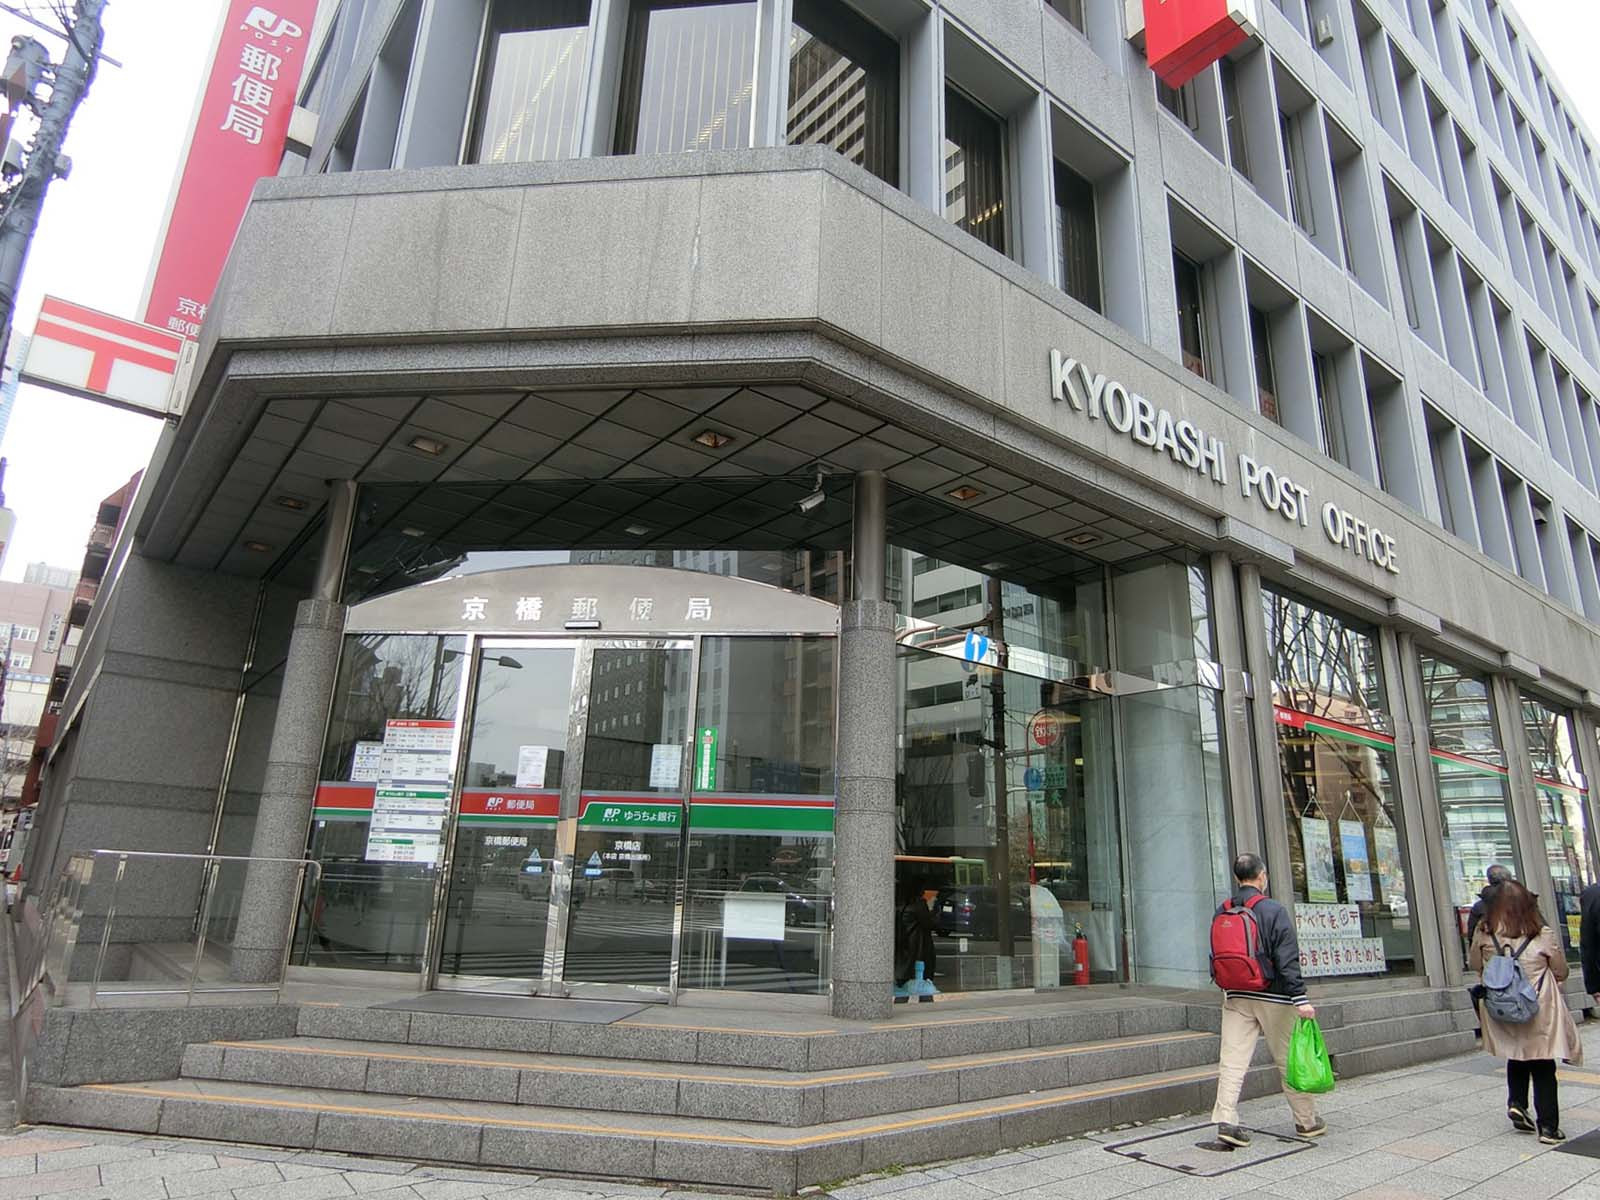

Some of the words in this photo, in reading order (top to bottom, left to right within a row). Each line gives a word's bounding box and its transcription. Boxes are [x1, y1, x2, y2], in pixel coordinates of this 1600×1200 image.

[220, 43, 282, 145] 郵便局
[1049, 348, 1227, 485] KYOBASHI
[1238, 453, 1310, 527] POST
[1321, 501, 1400, 575] OFFICE
[461, 597, 712, 622] 京橋郵便局
[506, 799, 535, 810] 郵便局
[623, 810, 677, 823] ゆうちょ銀行
[484, 836, 528, 848] 京橋郵便局
[614, 840, 642, 852] 京橋店
